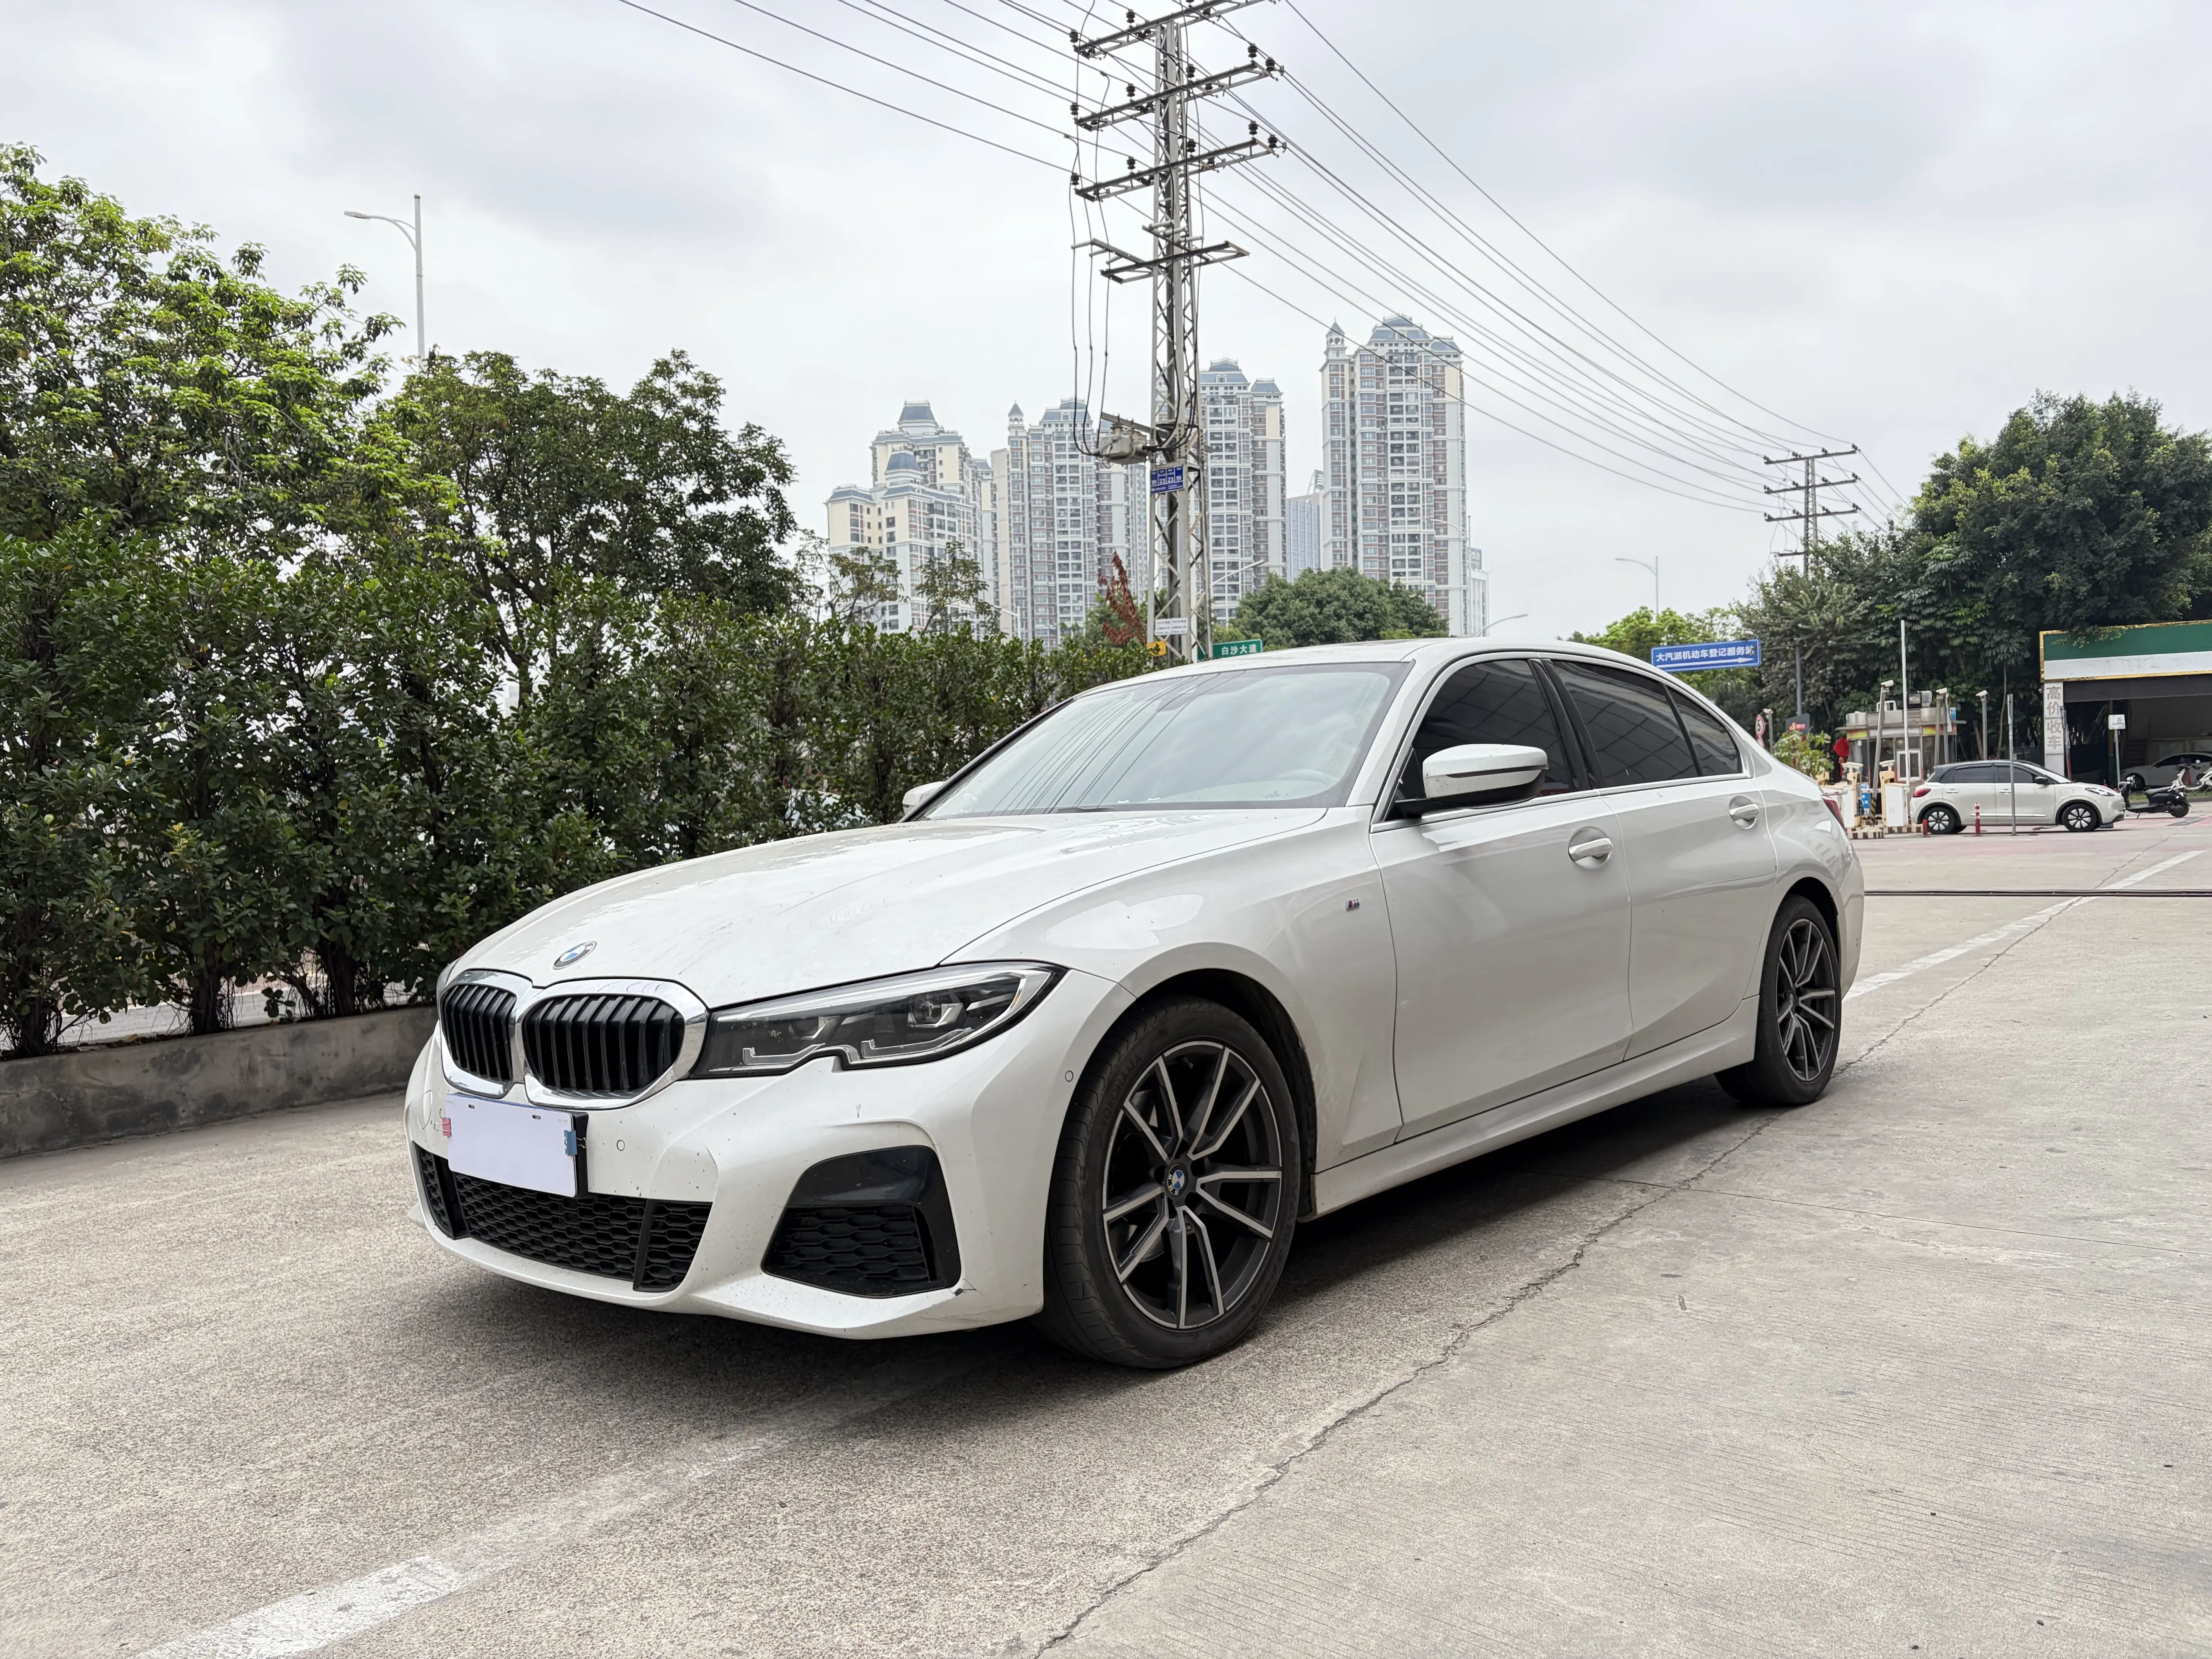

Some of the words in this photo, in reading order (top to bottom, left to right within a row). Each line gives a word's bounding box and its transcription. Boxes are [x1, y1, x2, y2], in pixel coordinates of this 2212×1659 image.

[1221, 644, 1257, 655] 白沙大道
[1656, 645, 1755, 662] 大汽派机动车登记服务站
[2047, 686, 2061, 749] 高价收车
[1099, 1053, 1142, 1127] YOKOHAMA
[1168, 1173, 1179, 1196] BMW
